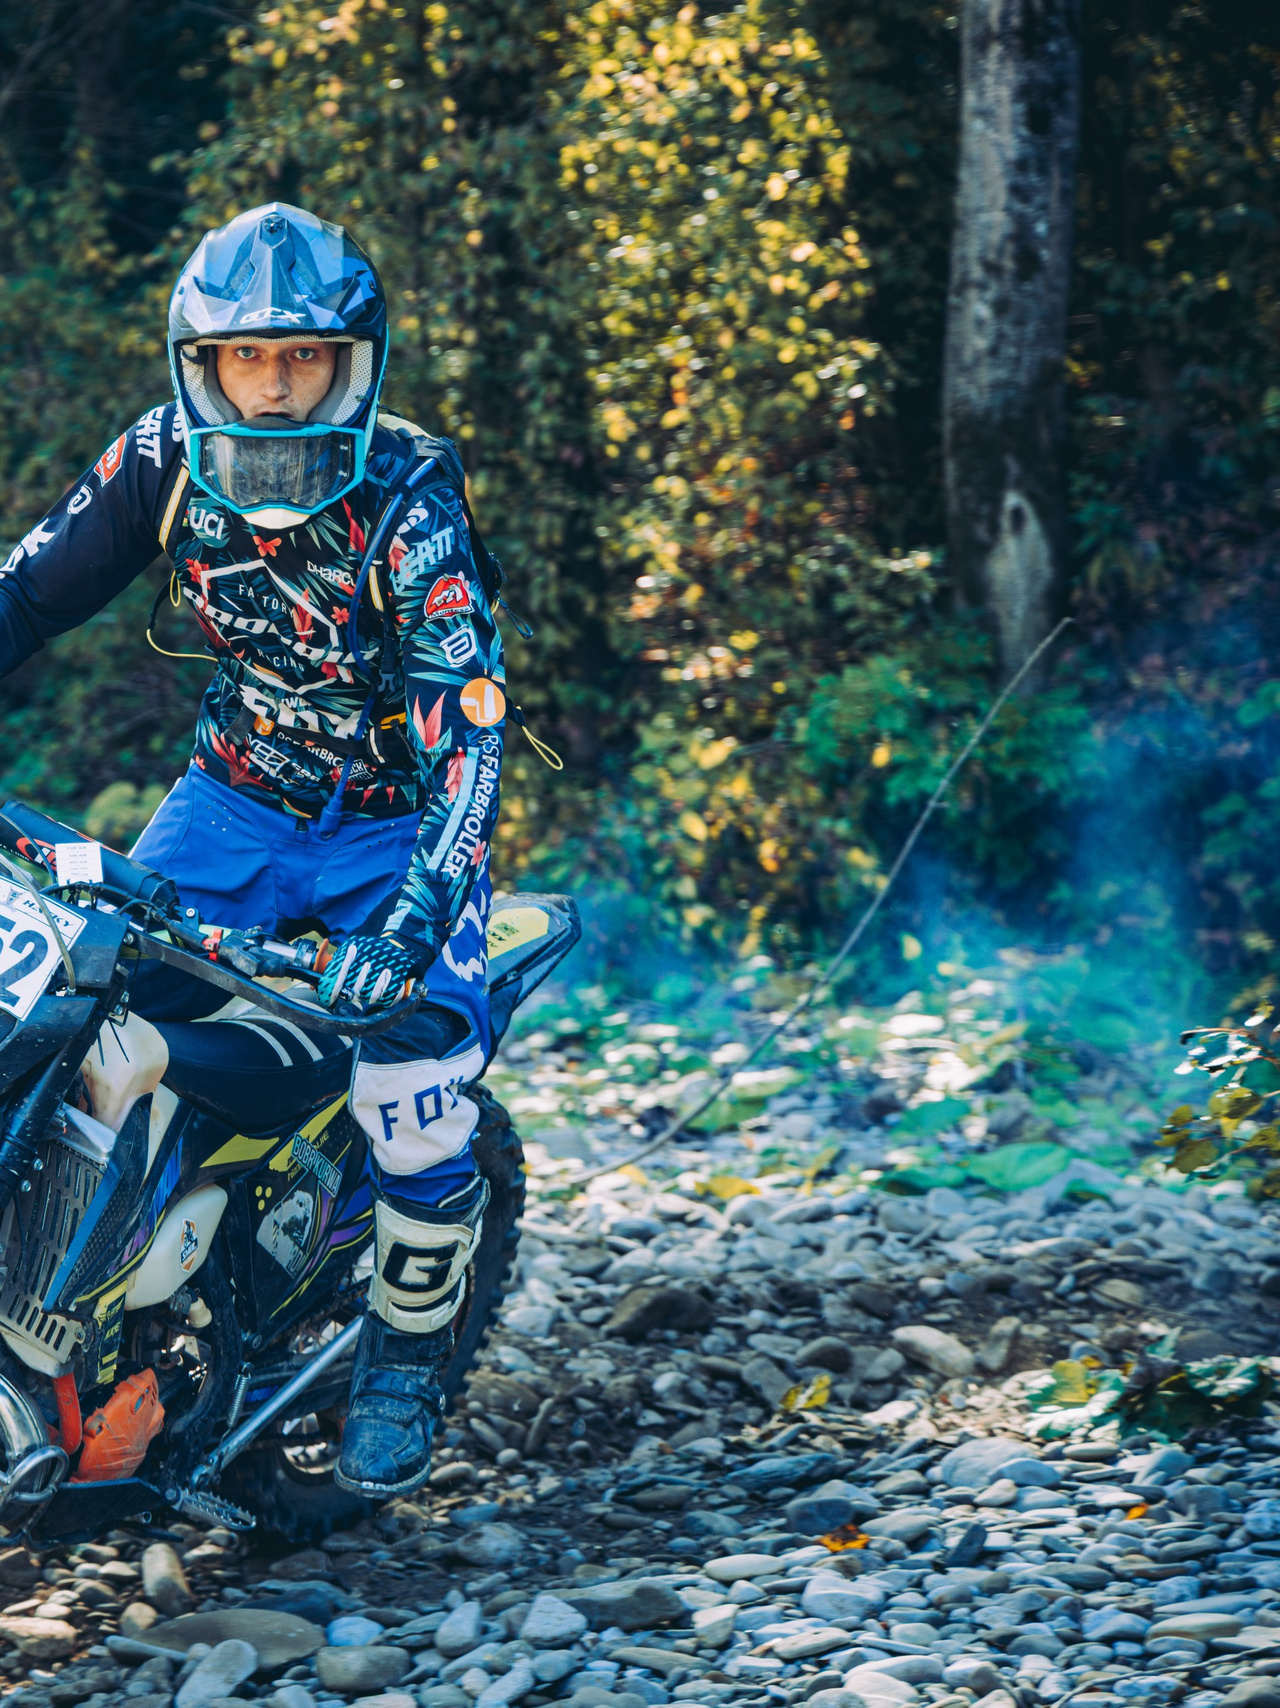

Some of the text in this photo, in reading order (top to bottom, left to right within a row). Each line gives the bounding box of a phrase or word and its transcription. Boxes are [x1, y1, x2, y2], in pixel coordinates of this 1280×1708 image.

[136, 405, 166, 468] EATT
[189, 507, 224, 541] UCI
[238, 583, 295, 619] FATORY
[257, 648, 305, 673] RCING
